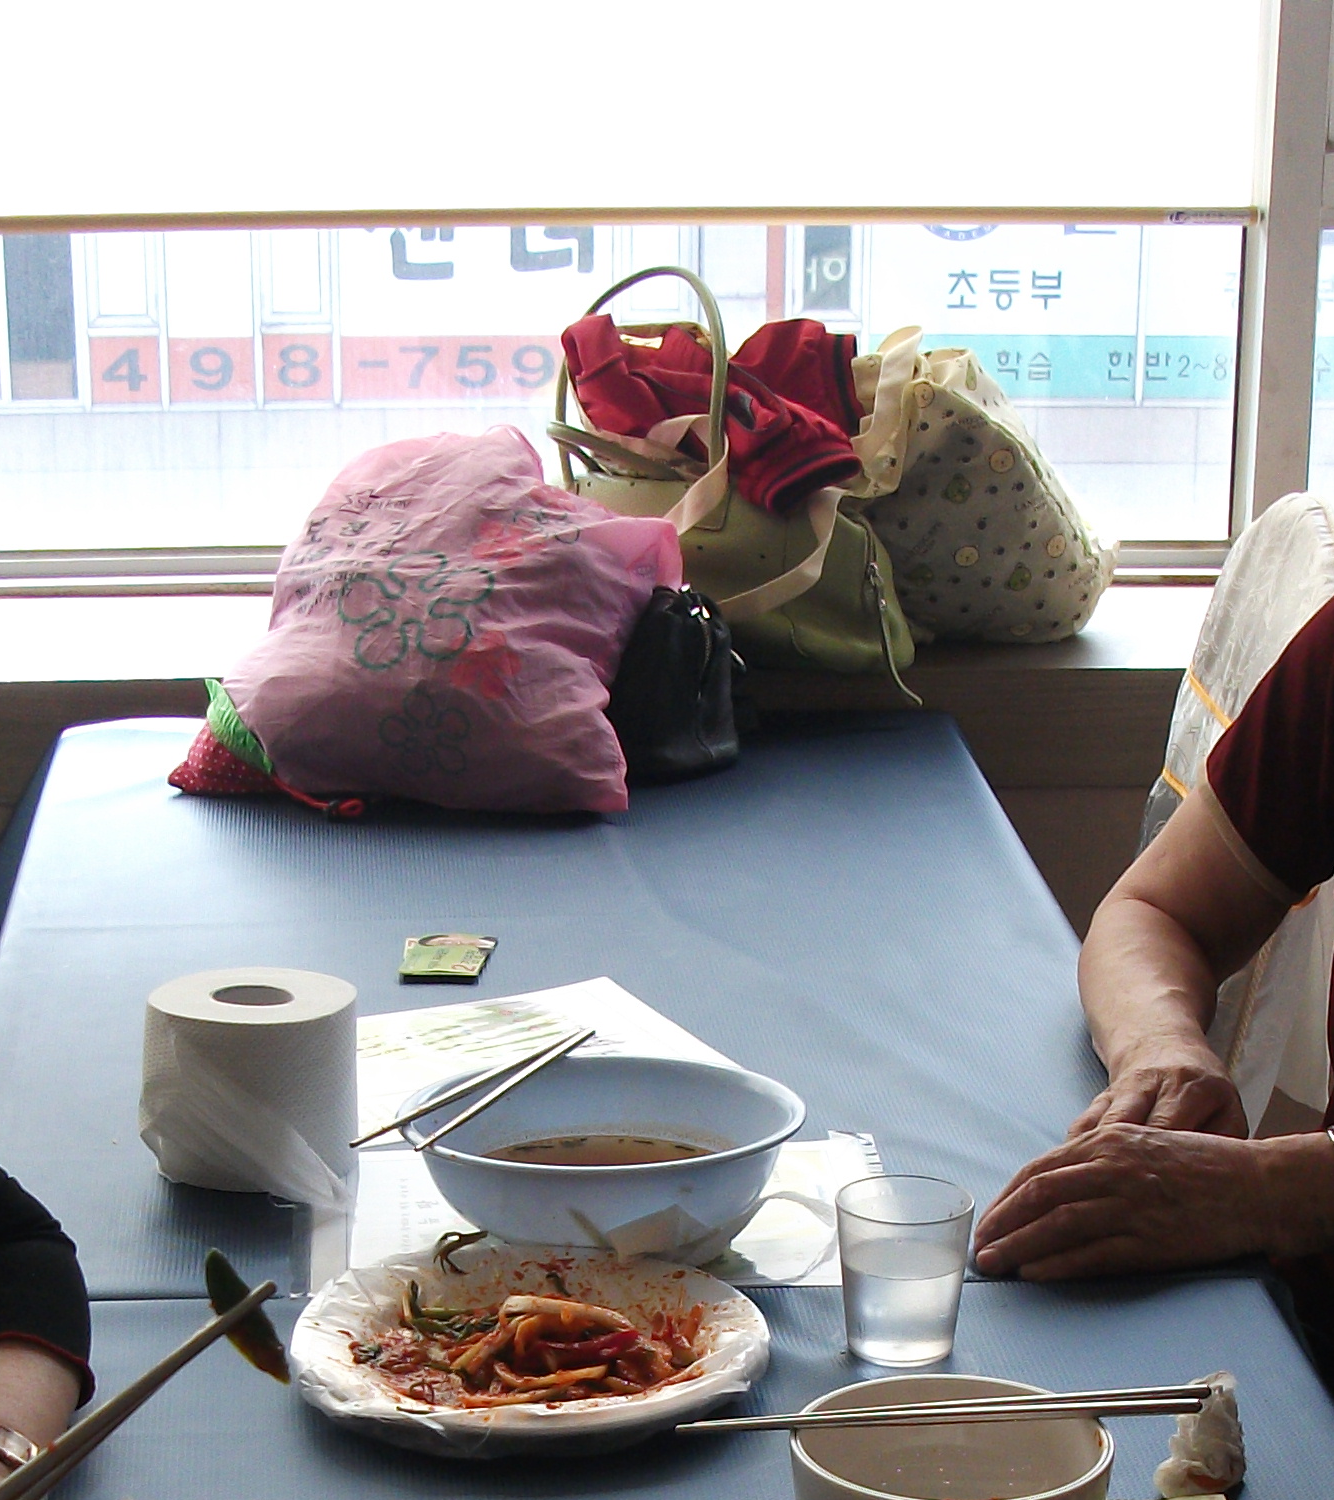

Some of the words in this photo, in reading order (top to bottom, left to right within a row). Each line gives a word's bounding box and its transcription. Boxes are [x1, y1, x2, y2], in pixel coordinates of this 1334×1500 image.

[946, 269, 1063, 312] 초등부
[101, 343, 556, 392] 498-759
[996, 350, 1053, 382] 학습
